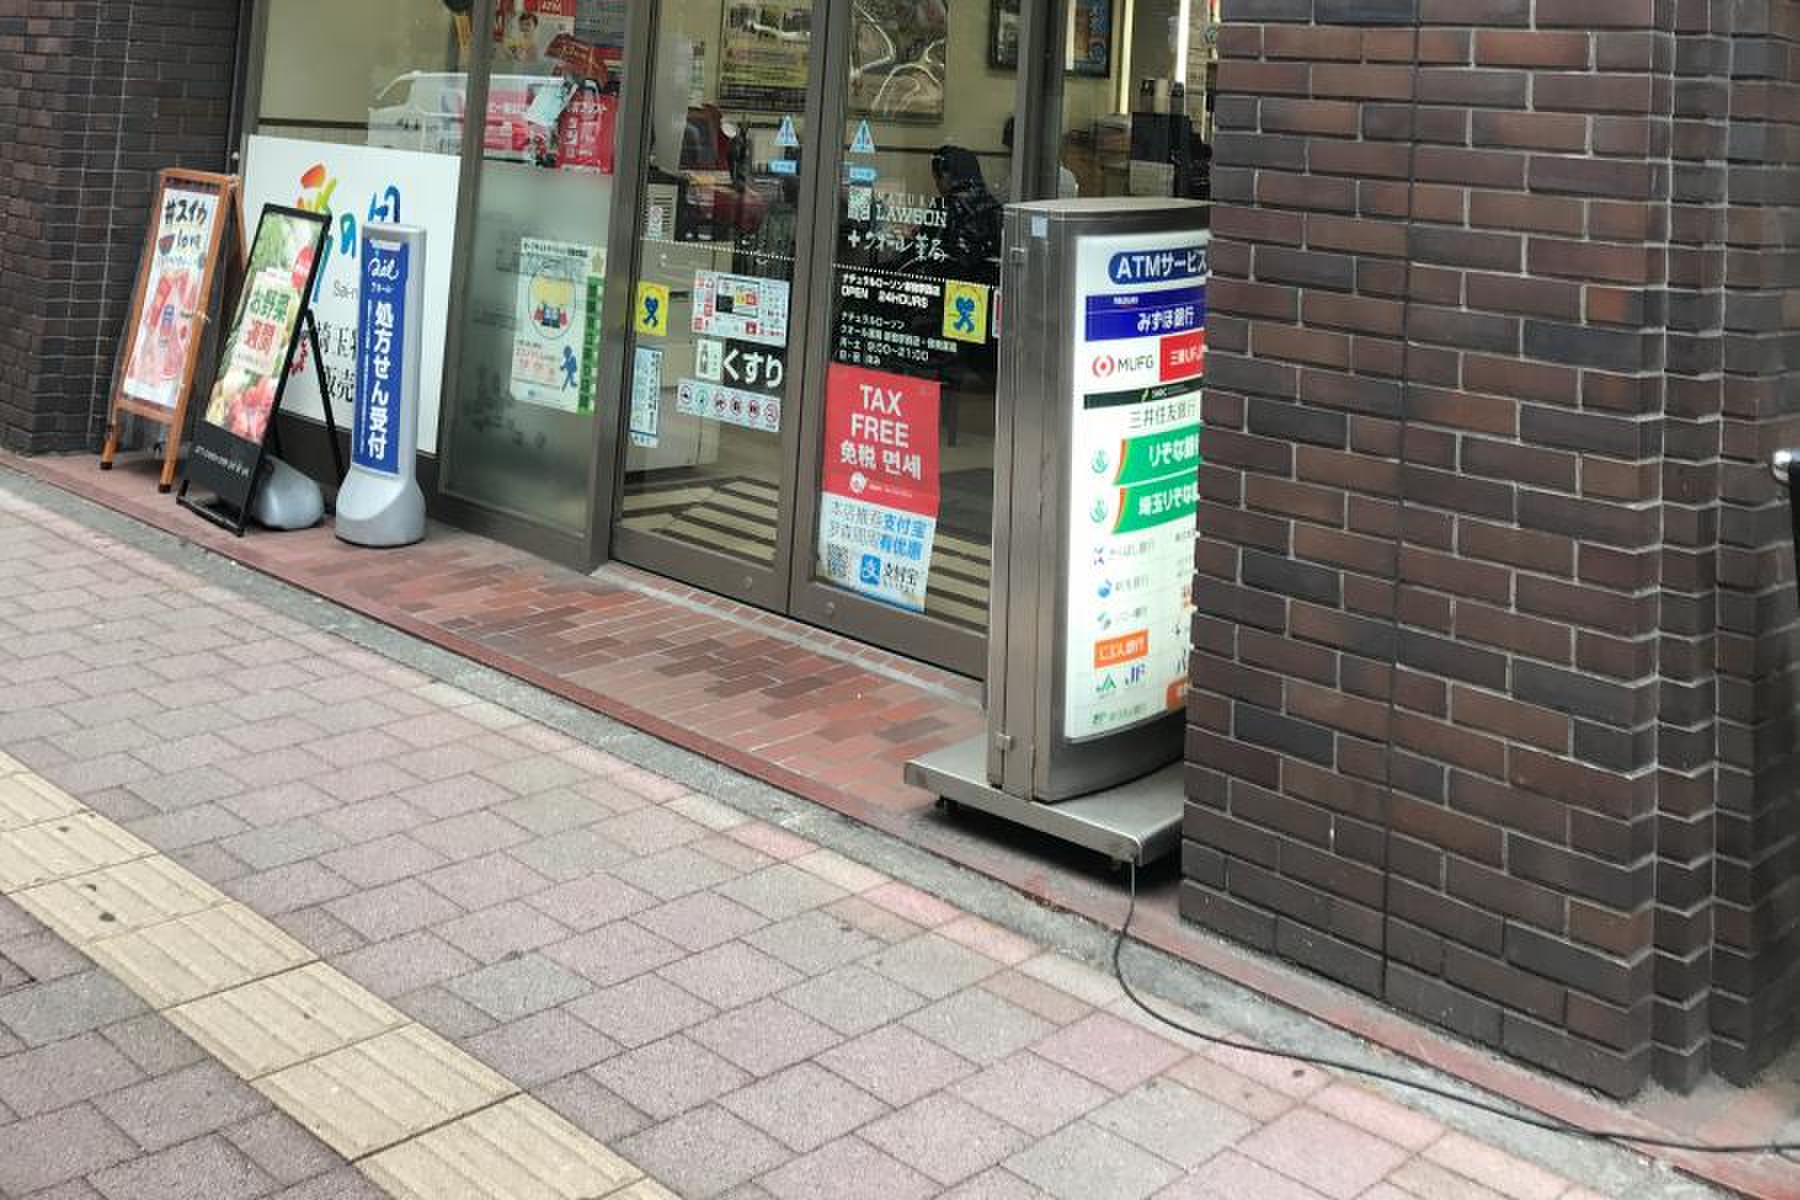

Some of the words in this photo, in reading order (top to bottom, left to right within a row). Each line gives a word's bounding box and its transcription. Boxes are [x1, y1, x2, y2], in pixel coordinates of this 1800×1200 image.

[876, 204, 948, 228] LAWSON
[841, 284, 869, 300] OPEN
[1137, 306, 1195, 333] みずほ銀行
[722, 348, 784, 389] くすり
[1117, 354, 1154, 374] MUFG
[367, 301, 394, 460] 処方せん受付
[859, 383, 903, 417] TAX
[851, 412, 909, 449] FREE
[883, 449, 922, 481] 면세
